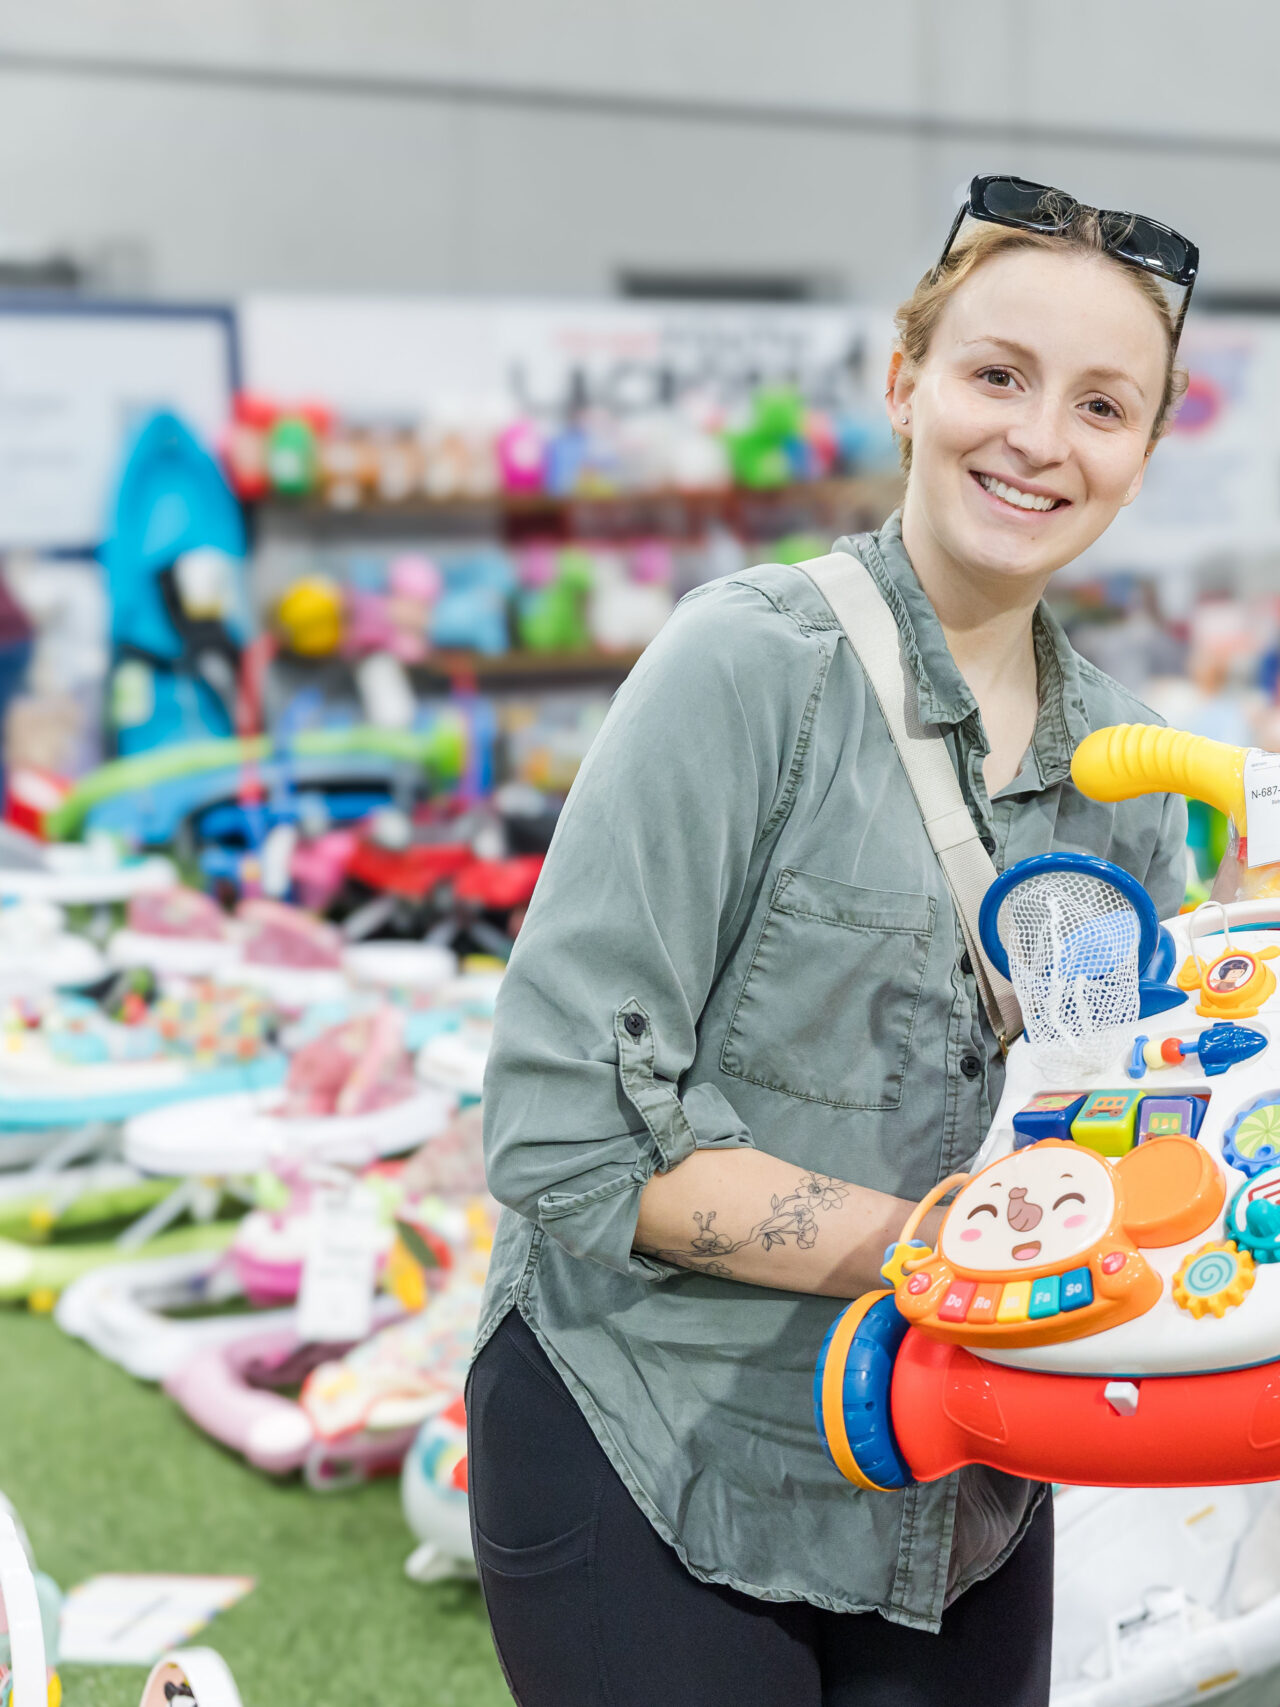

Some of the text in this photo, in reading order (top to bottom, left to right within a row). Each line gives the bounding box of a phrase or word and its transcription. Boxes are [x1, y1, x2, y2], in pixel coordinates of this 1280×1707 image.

[945, 1294, 962, 1308] Do
[973, 1295, 991, 1310] Re
[1034, 1291, 1050, 1305] Fa
[1065, 1282, 1083, 1297] So
